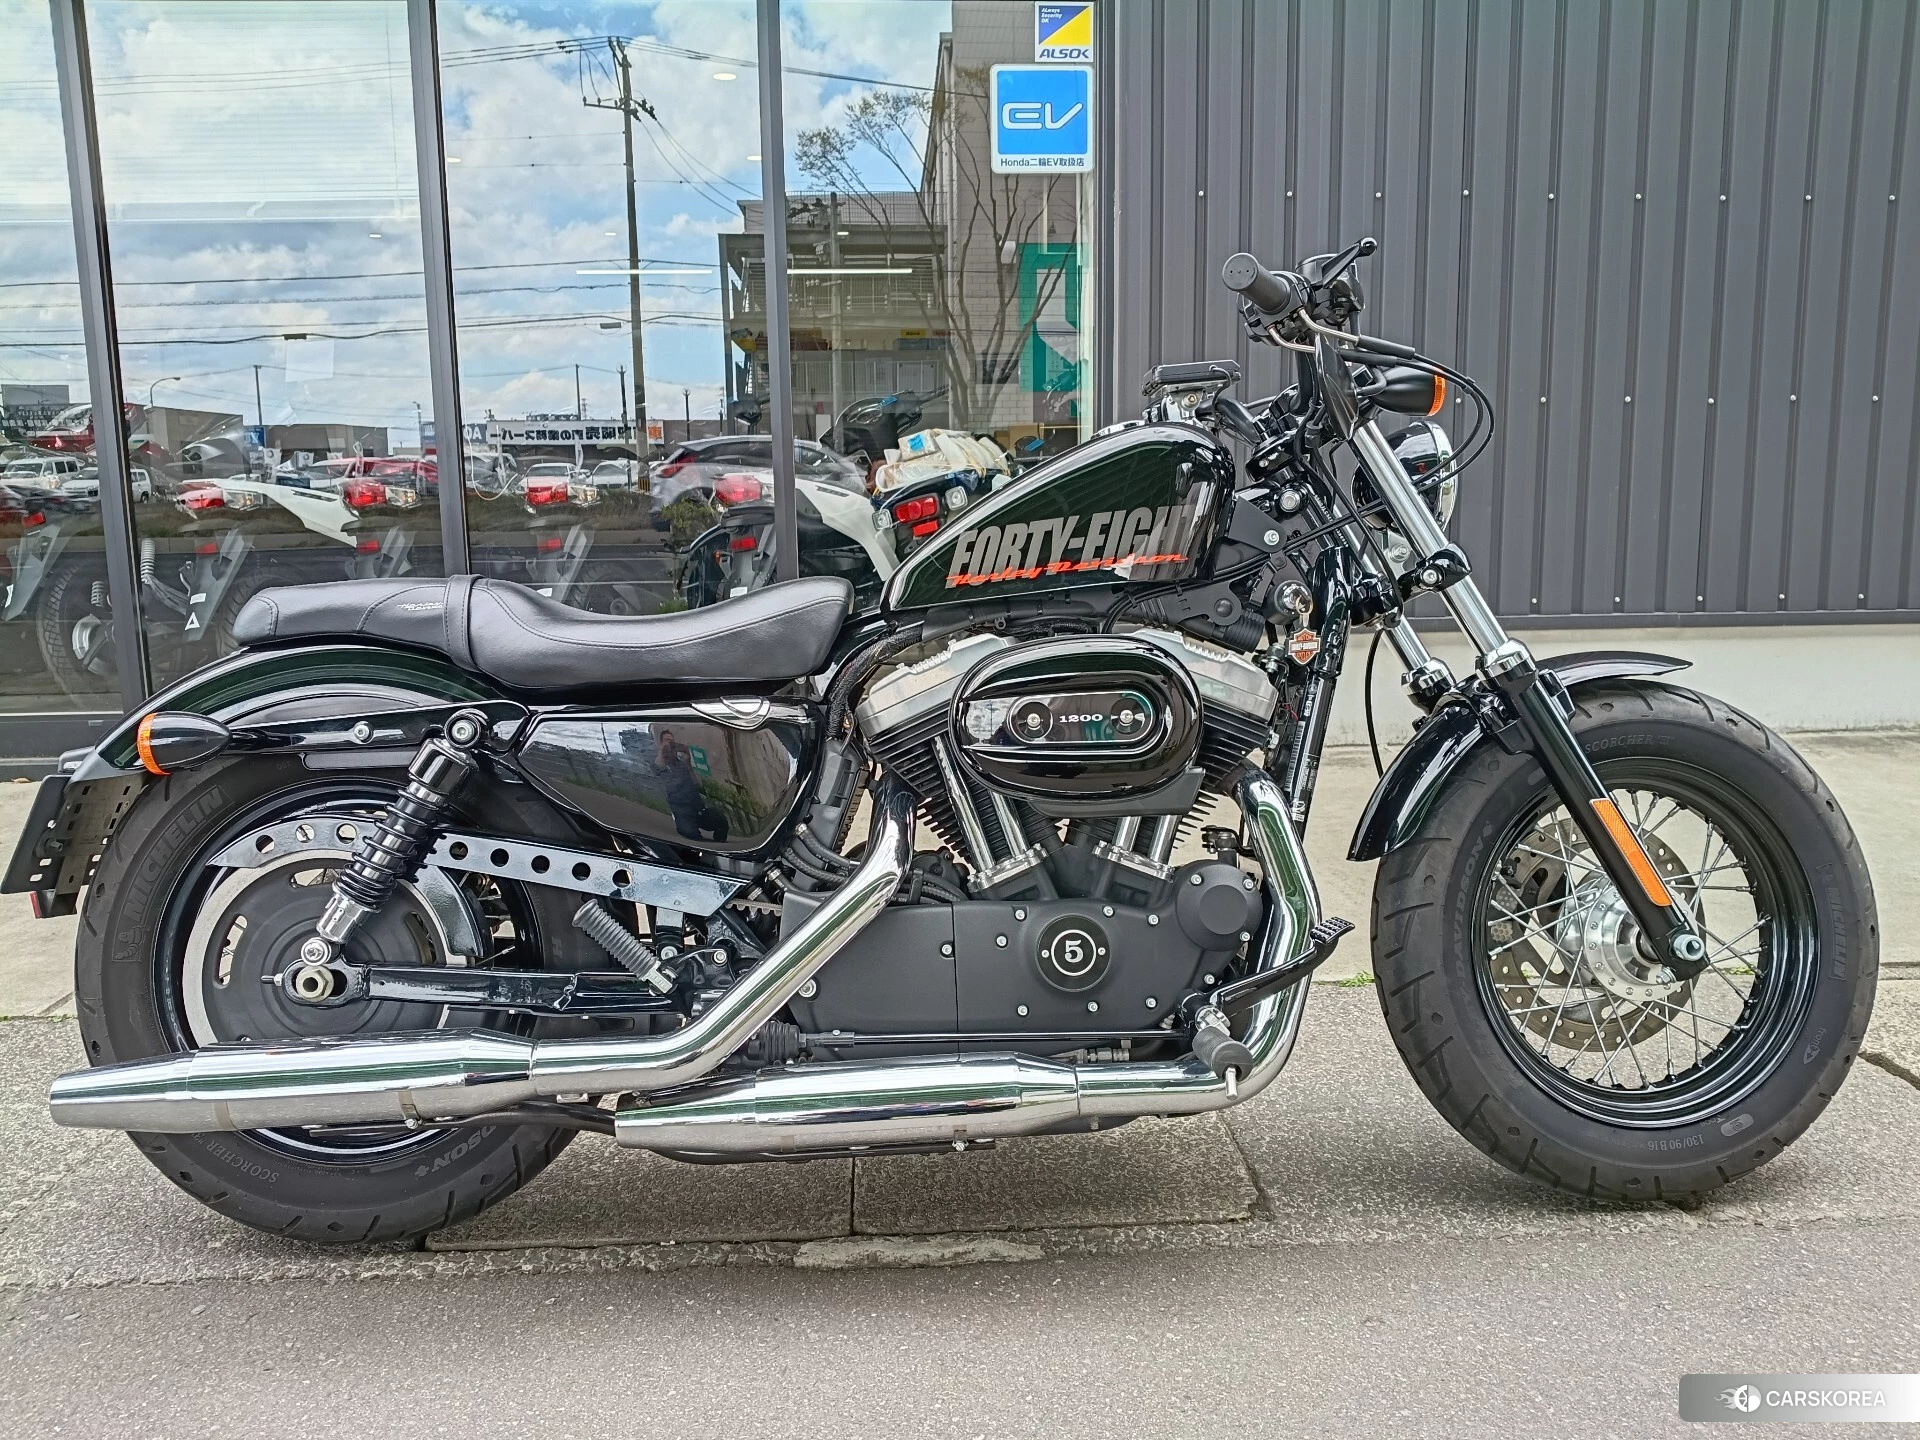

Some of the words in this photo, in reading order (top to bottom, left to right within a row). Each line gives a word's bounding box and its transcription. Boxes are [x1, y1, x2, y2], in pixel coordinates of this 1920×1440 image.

[1039, 48, 1090, 59] ALSOK
[1002, 102, 1083, 130] EV
[1000, 157, 1085, 167] Honda二輪EV取扱店
[1059, 713, 1104, 723] 1200
[1585, 734, 1654, 754] SCORCHER
[123, 786, 224, 923] MICHELIN
[1065, 940, 1084, 963] 5
[1647, 1140, 1667, 1151] B16
[1669, 1134, 1705, 1150] 130/90
[206, 1139, 280, 1184] SCORCHER
